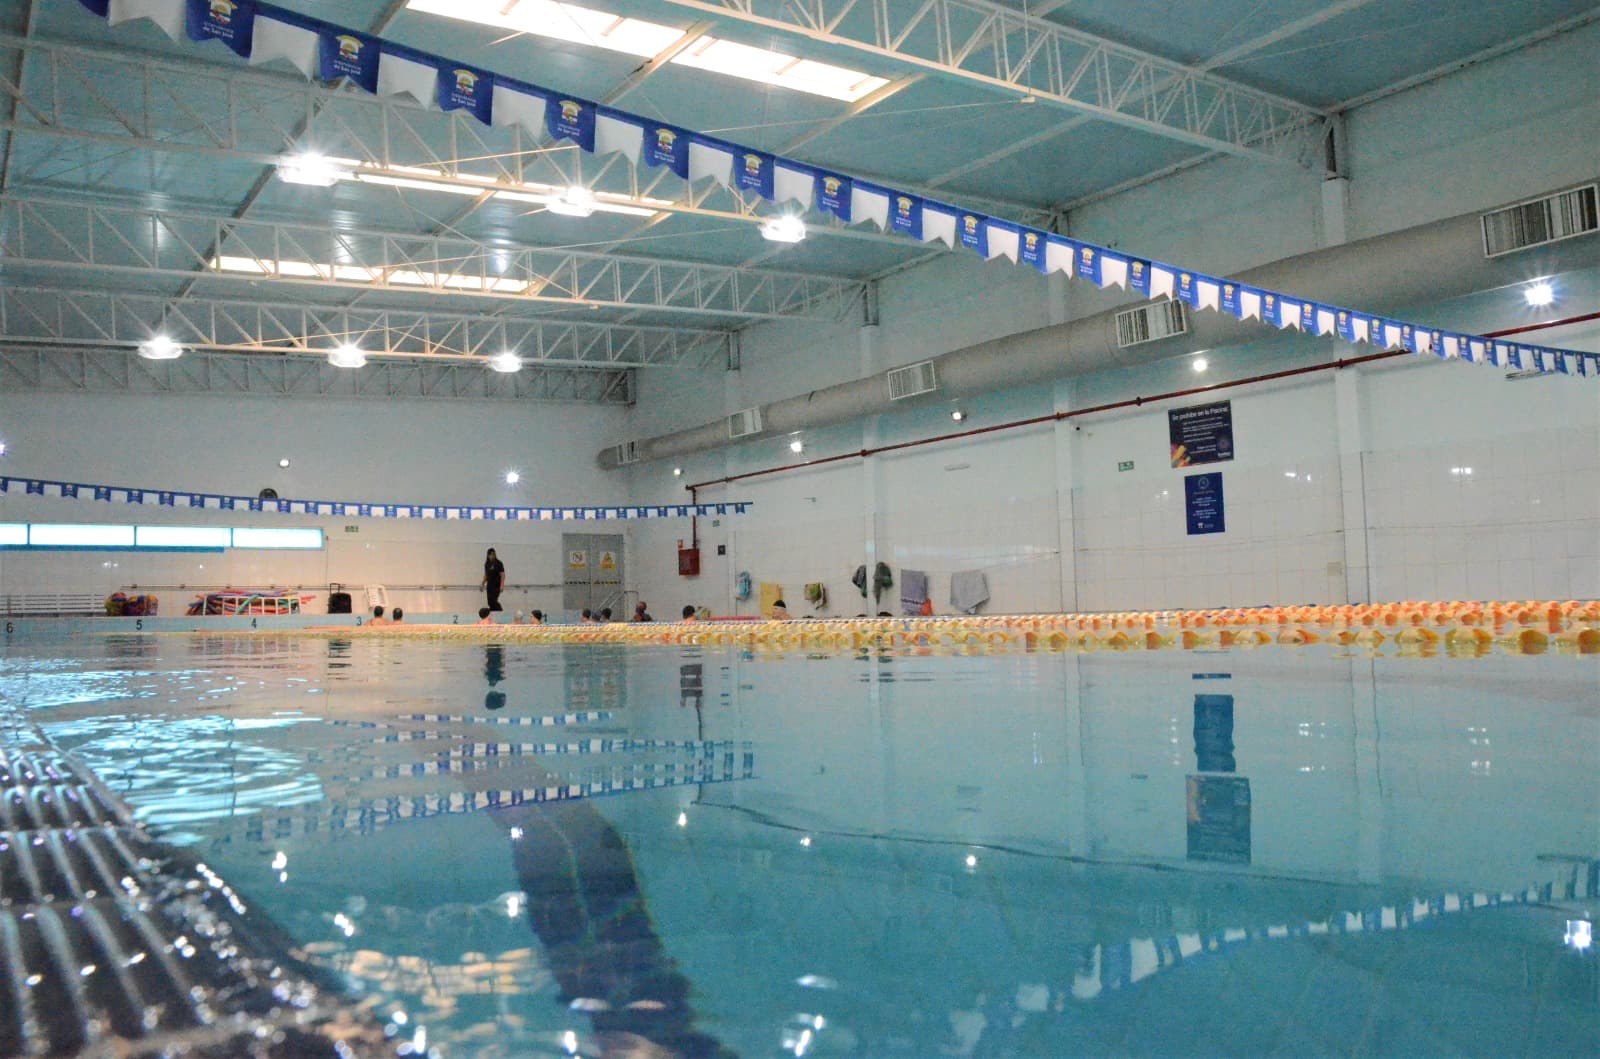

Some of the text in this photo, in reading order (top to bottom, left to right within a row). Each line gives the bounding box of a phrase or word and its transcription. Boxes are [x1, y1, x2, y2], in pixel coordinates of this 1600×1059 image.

[136, 619, 142, 630] 5
[251, 617, 257, 629] 4
[356, 616, 361, 626] 3
[453, 615, 458, 624] 2
[7, 622, 13, 633] 6
